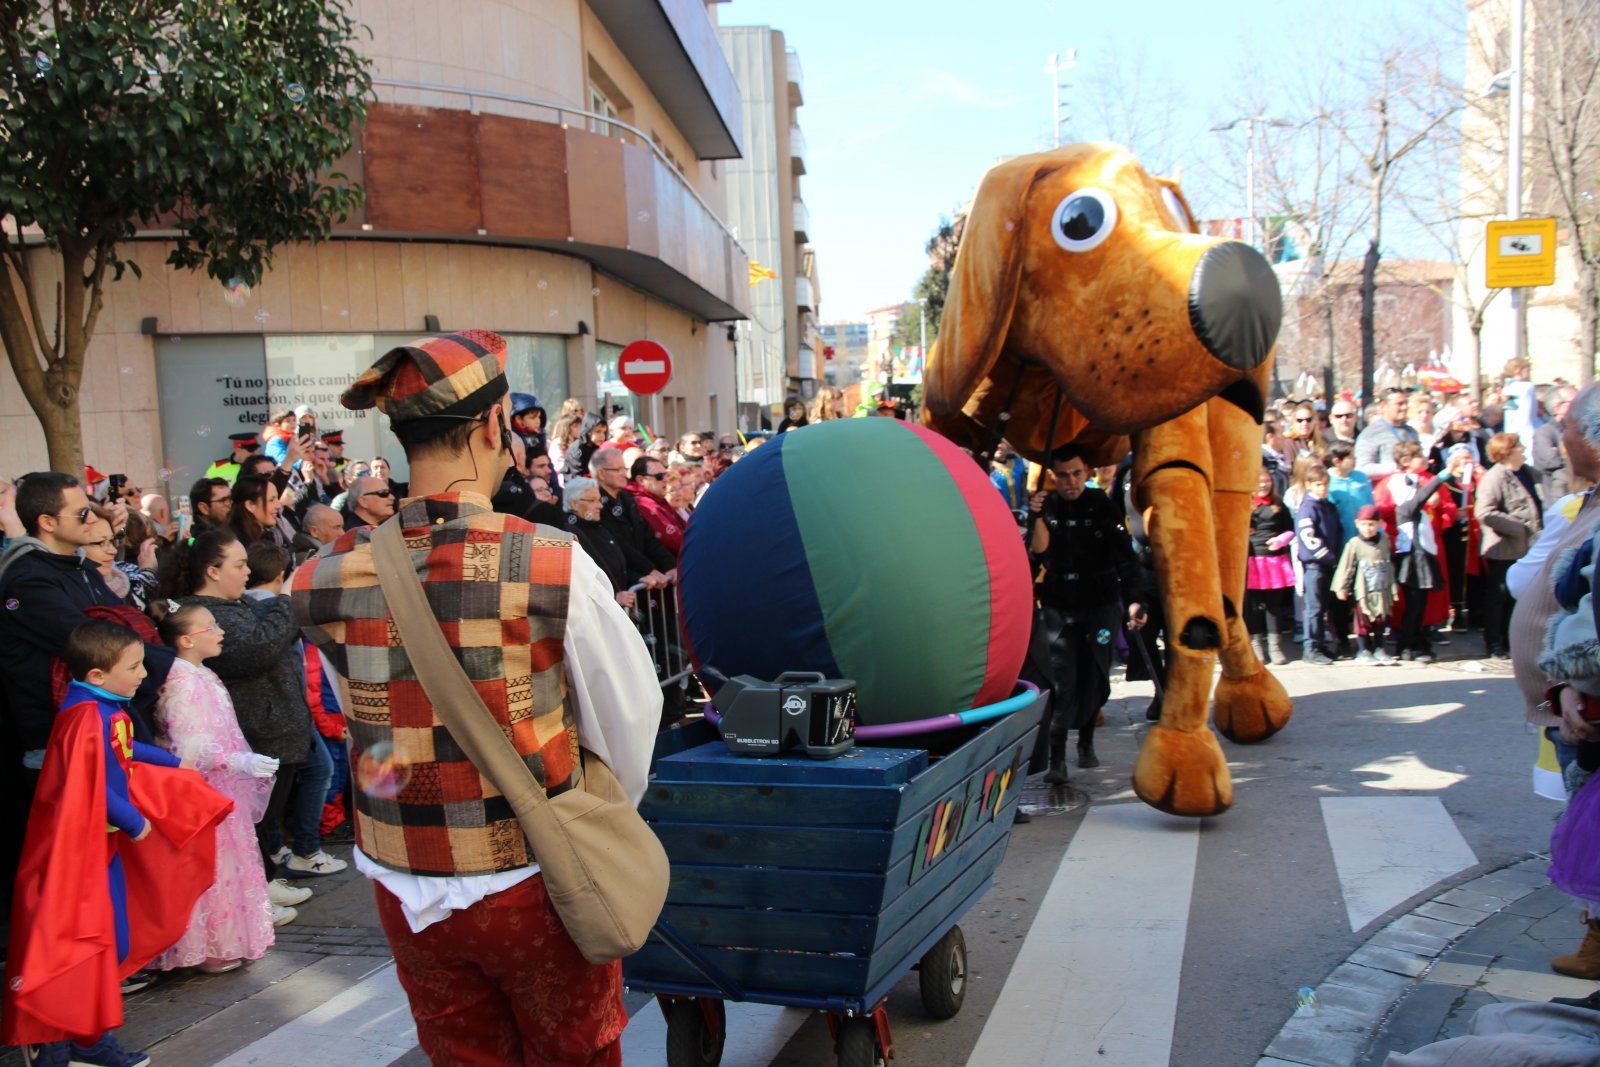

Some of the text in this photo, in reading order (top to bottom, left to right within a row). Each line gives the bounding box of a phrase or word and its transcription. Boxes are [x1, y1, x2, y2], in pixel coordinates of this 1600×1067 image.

[245, 379, 263, 388] no
[266, 374, 316, 391] puedes
[223, 392, 291, 407] situación,
[308, 393, 335, 407] que
[238, 410, 270, 425] elegi
